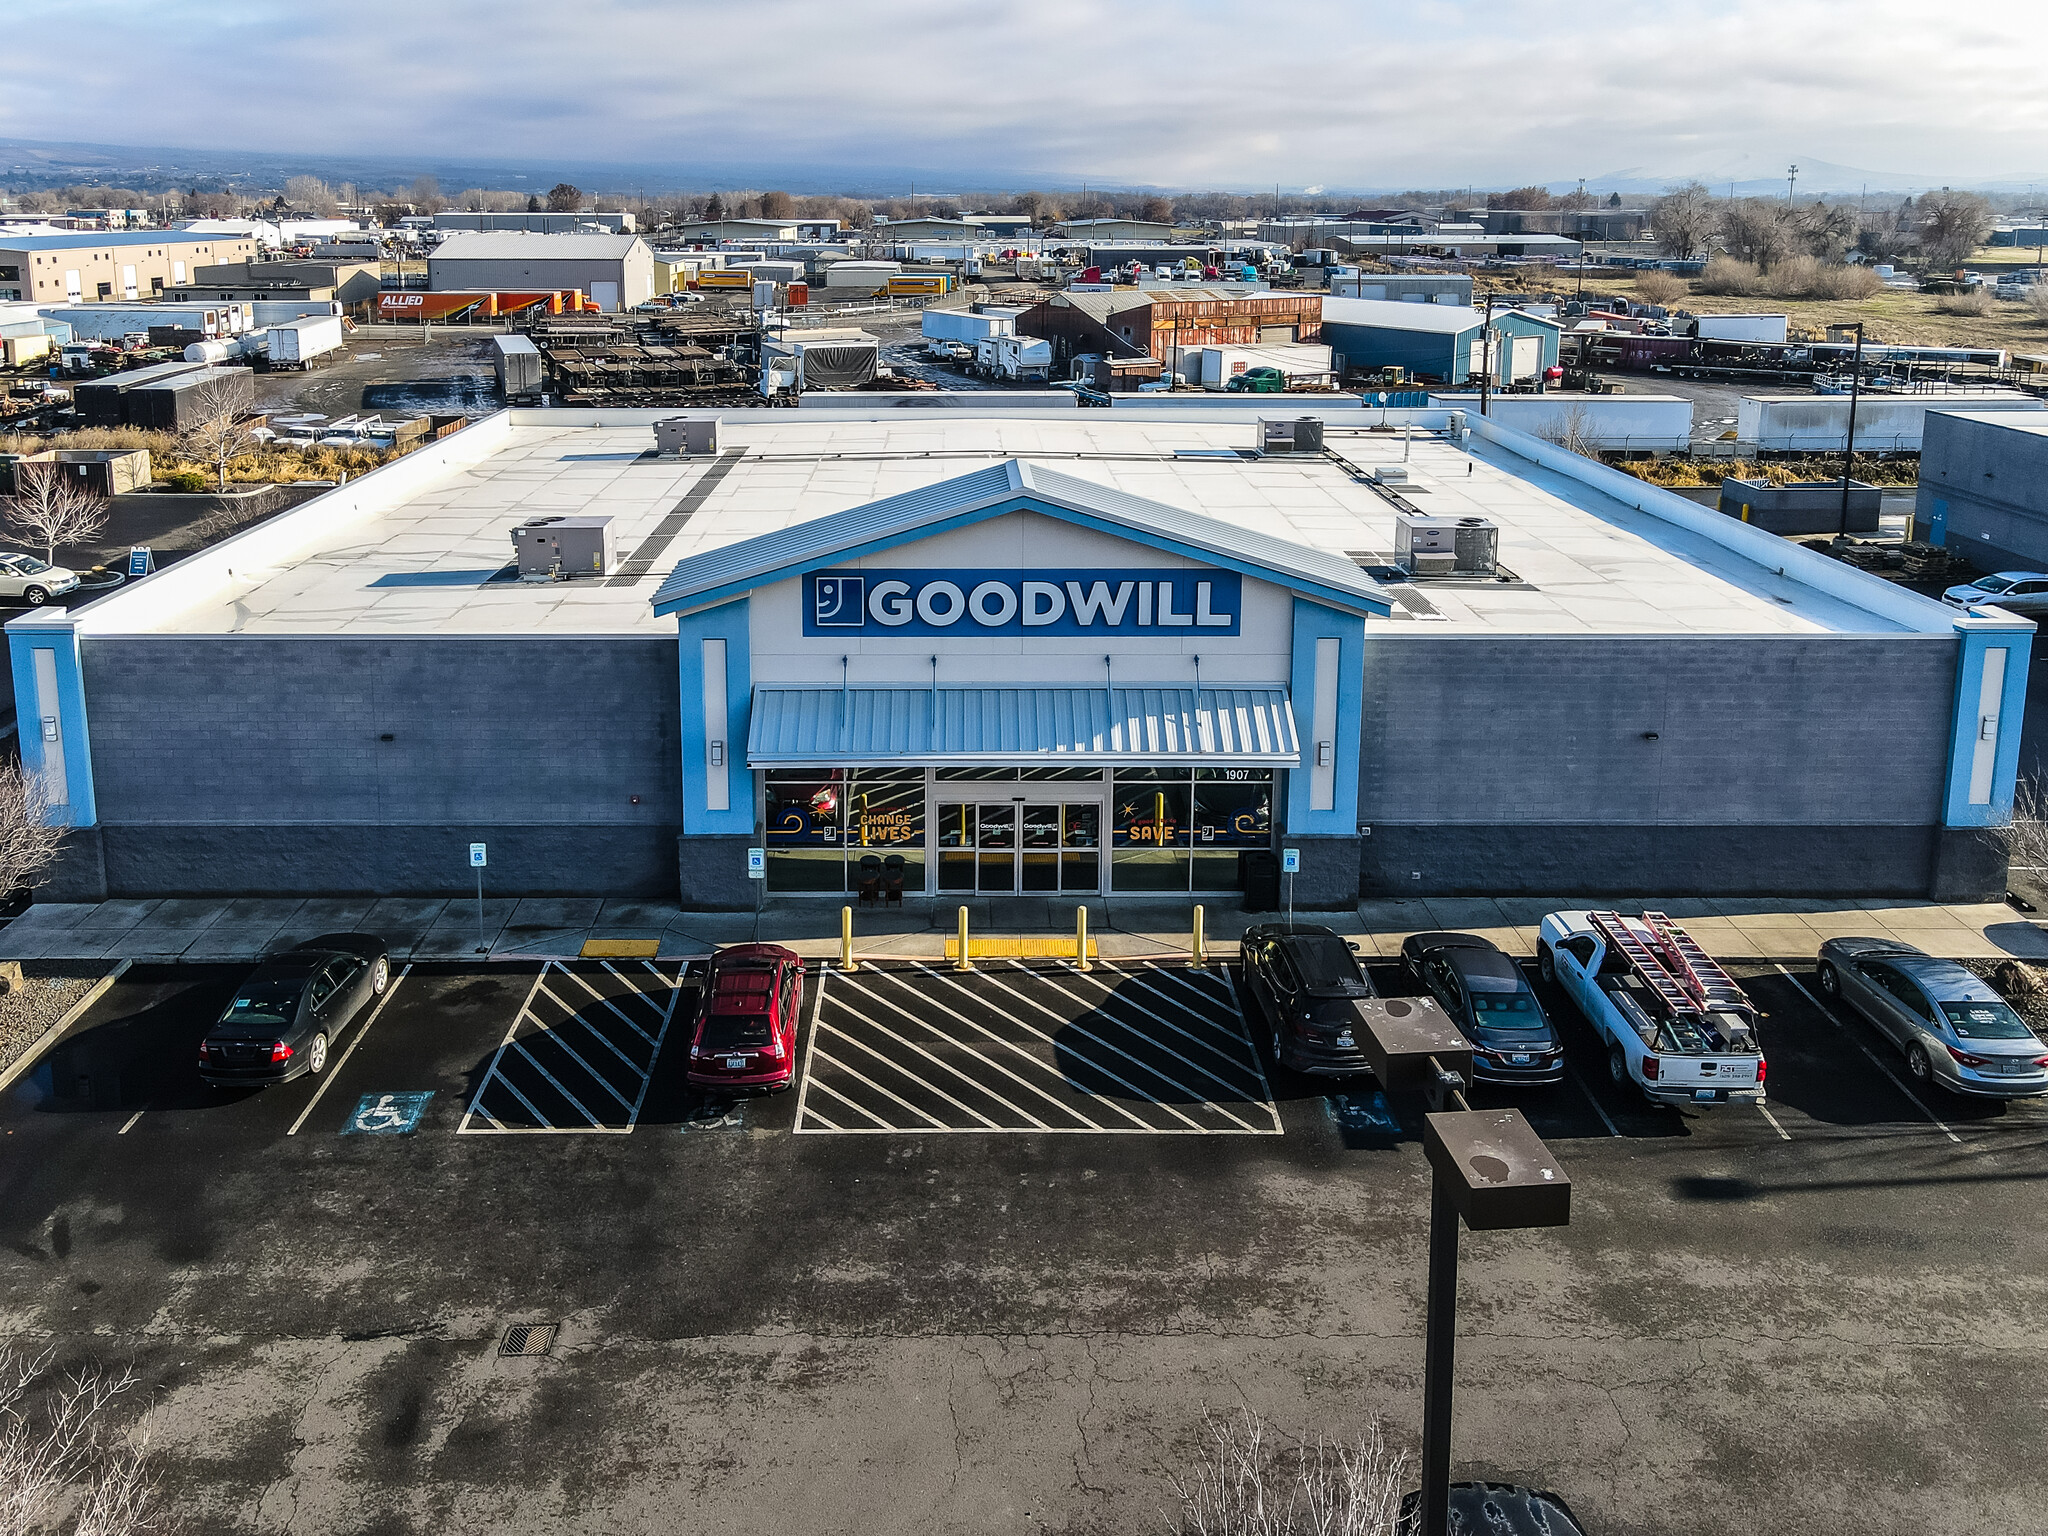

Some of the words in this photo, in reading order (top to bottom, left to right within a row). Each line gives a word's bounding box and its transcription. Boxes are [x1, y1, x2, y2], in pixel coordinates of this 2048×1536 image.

[382, 295, 424, 306] ALLIED
[868, 580, 1232, 626] GOODWILL
[1225, 769, 1249, 780] 1907
[860, 814, 912, 825] CHANGE
[861, 826, 911, 841] LIVES
[1129, 826, 1174, 840] SAVE
[1660, 1070, 1664, 1078] 1
